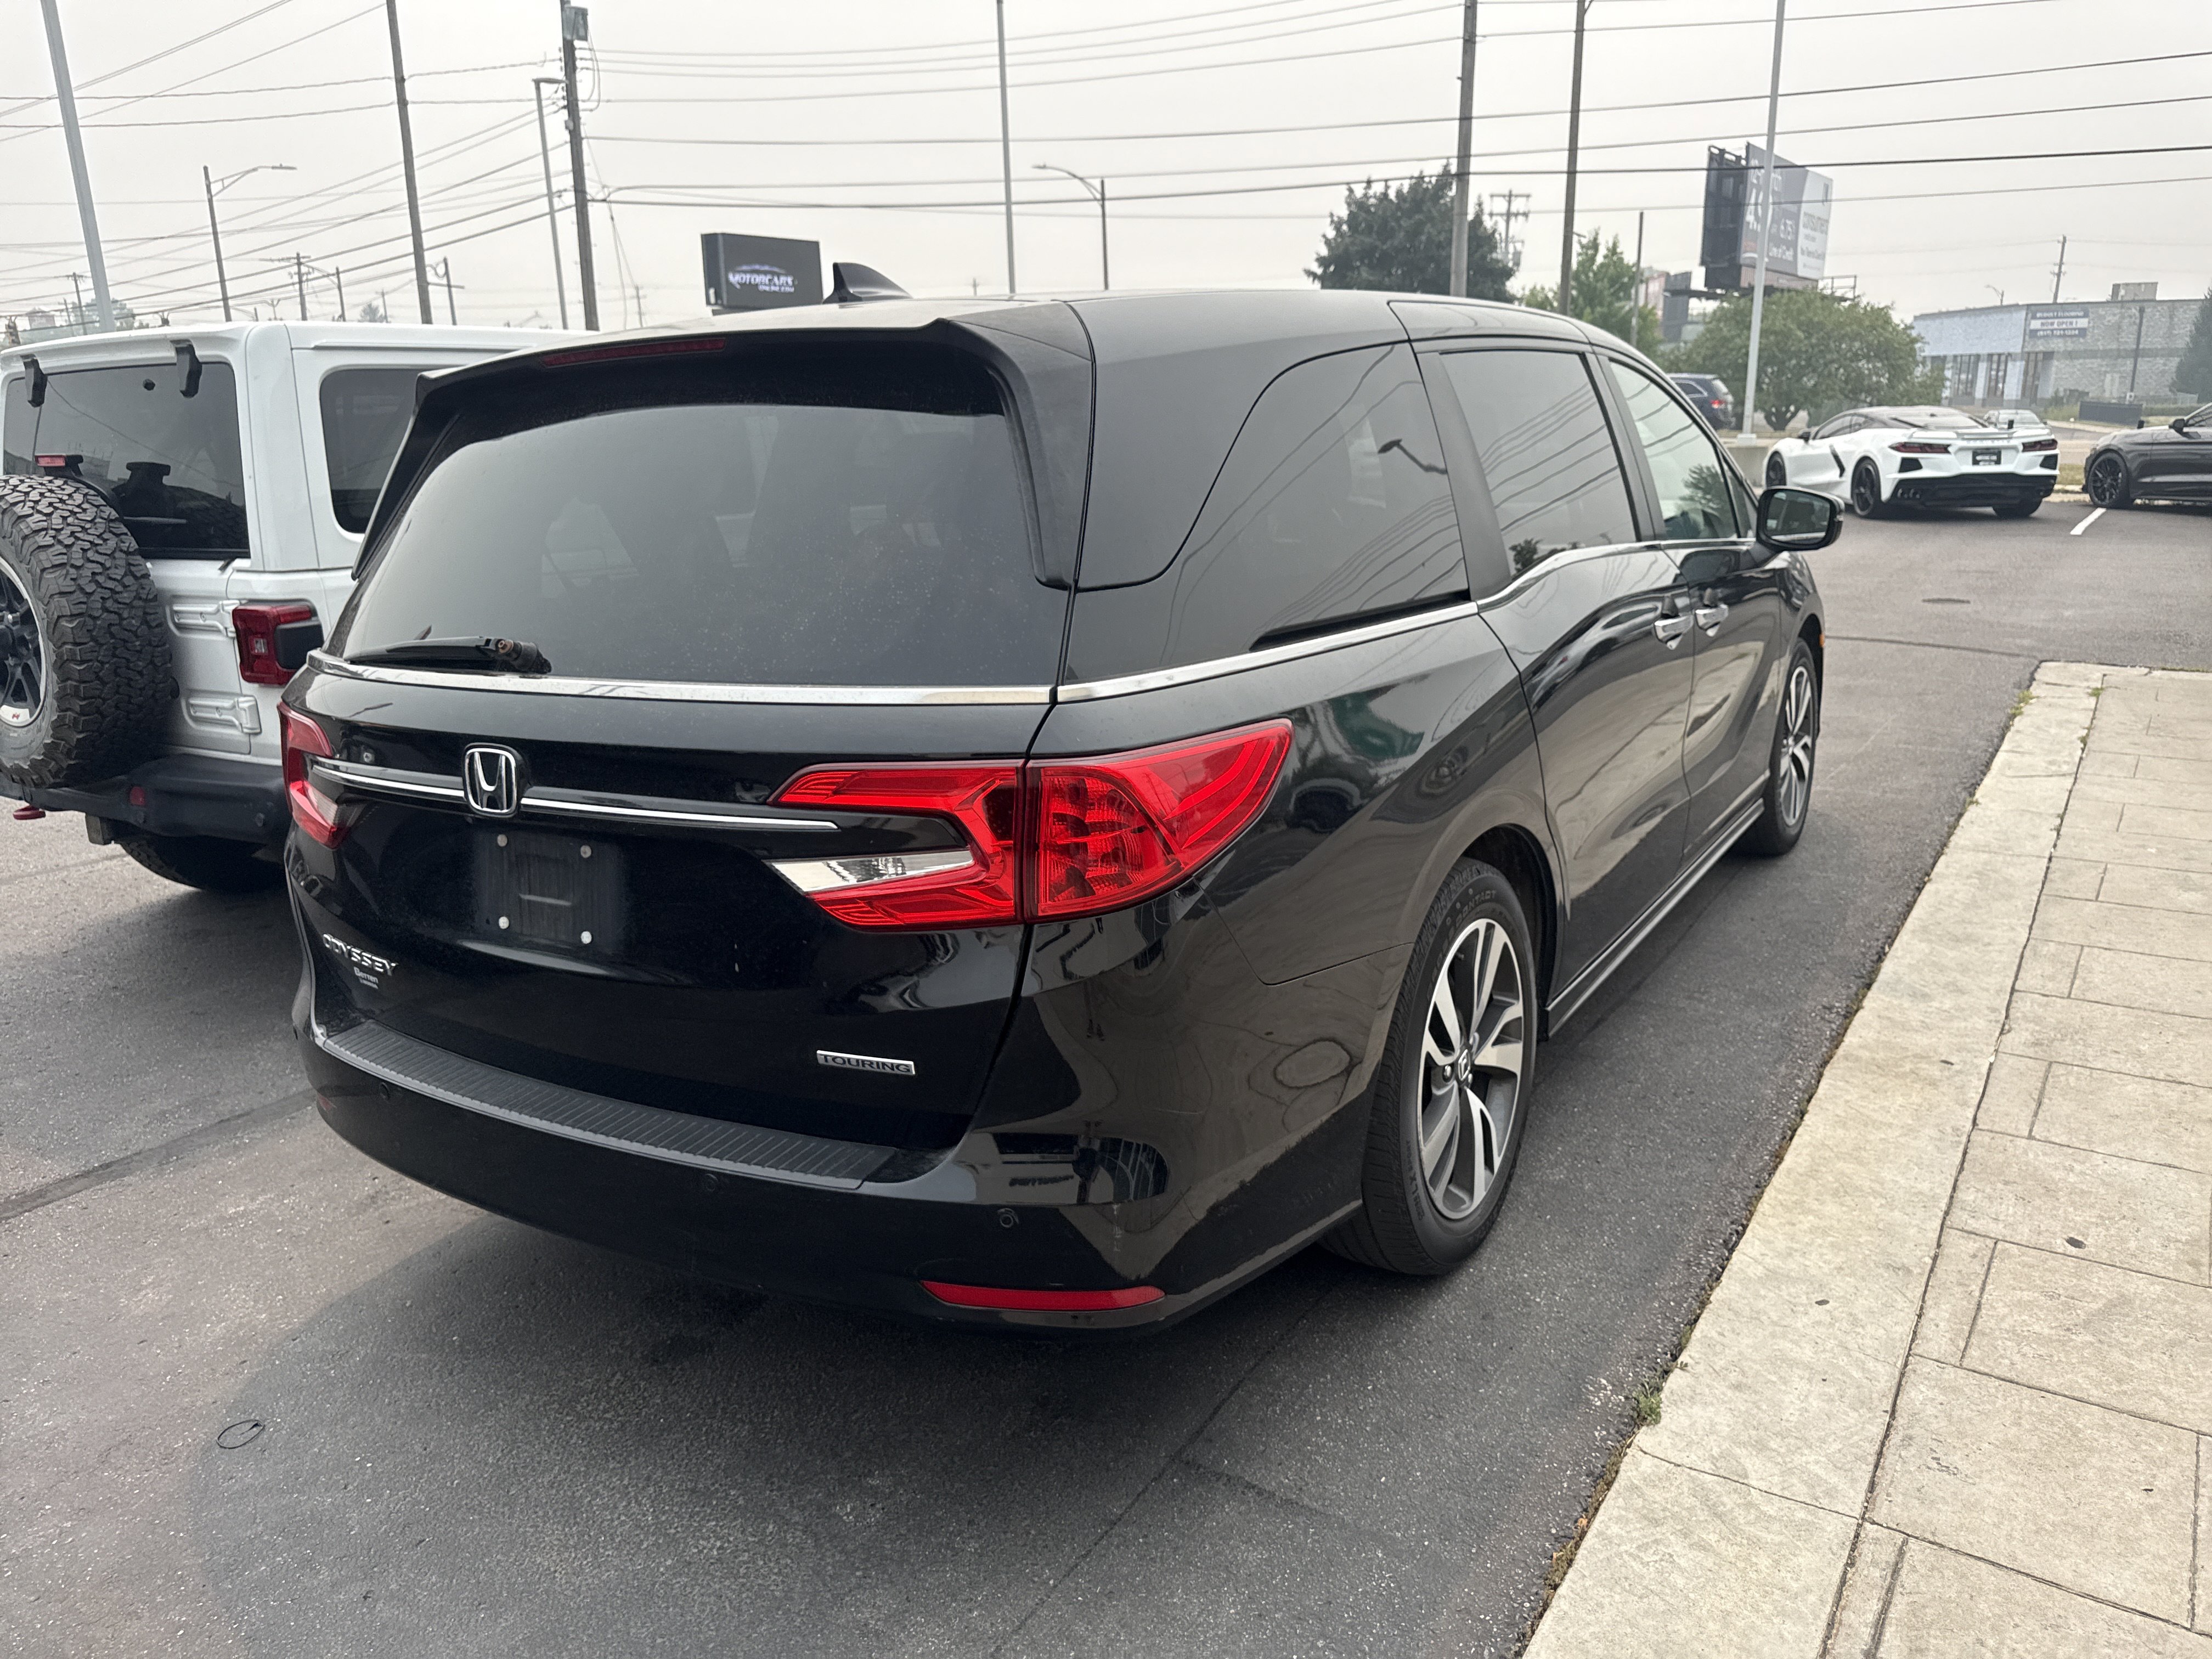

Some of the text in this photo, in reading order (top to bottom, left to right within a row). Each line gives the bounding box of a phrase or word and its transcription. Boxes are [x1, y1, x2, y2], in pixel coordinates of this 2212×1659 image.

[728, 272, 794, 286] MOTORCARS
[323, 934, 399, 976] ODYSSEY
[819, 1054, 911, 1073] TOURING
